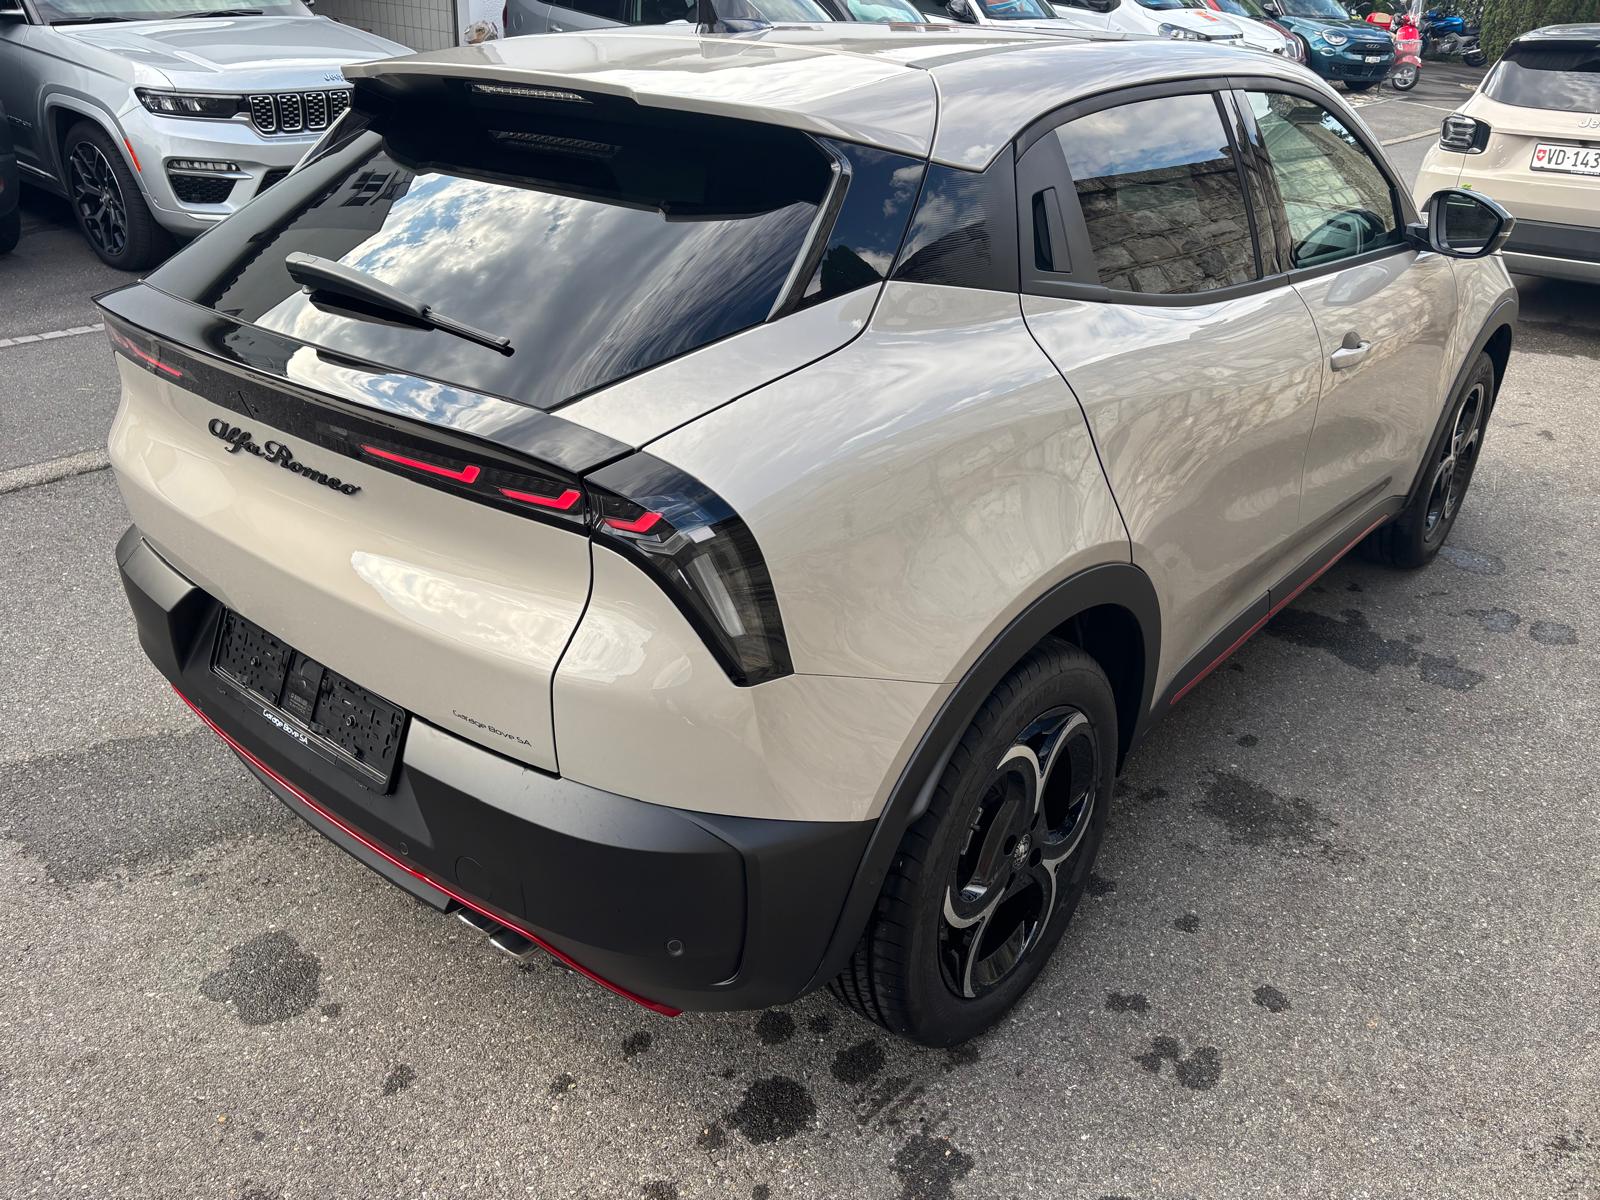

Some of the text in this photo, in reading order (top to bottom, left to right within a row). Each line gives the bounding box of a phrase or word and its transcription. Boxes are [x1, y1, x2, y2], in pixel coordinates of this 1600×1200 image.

[1577, 116, 1600, 129] Je
[208, 418, 361, 495] Alfa Romeo
[516, 736, 532, 748] SA
